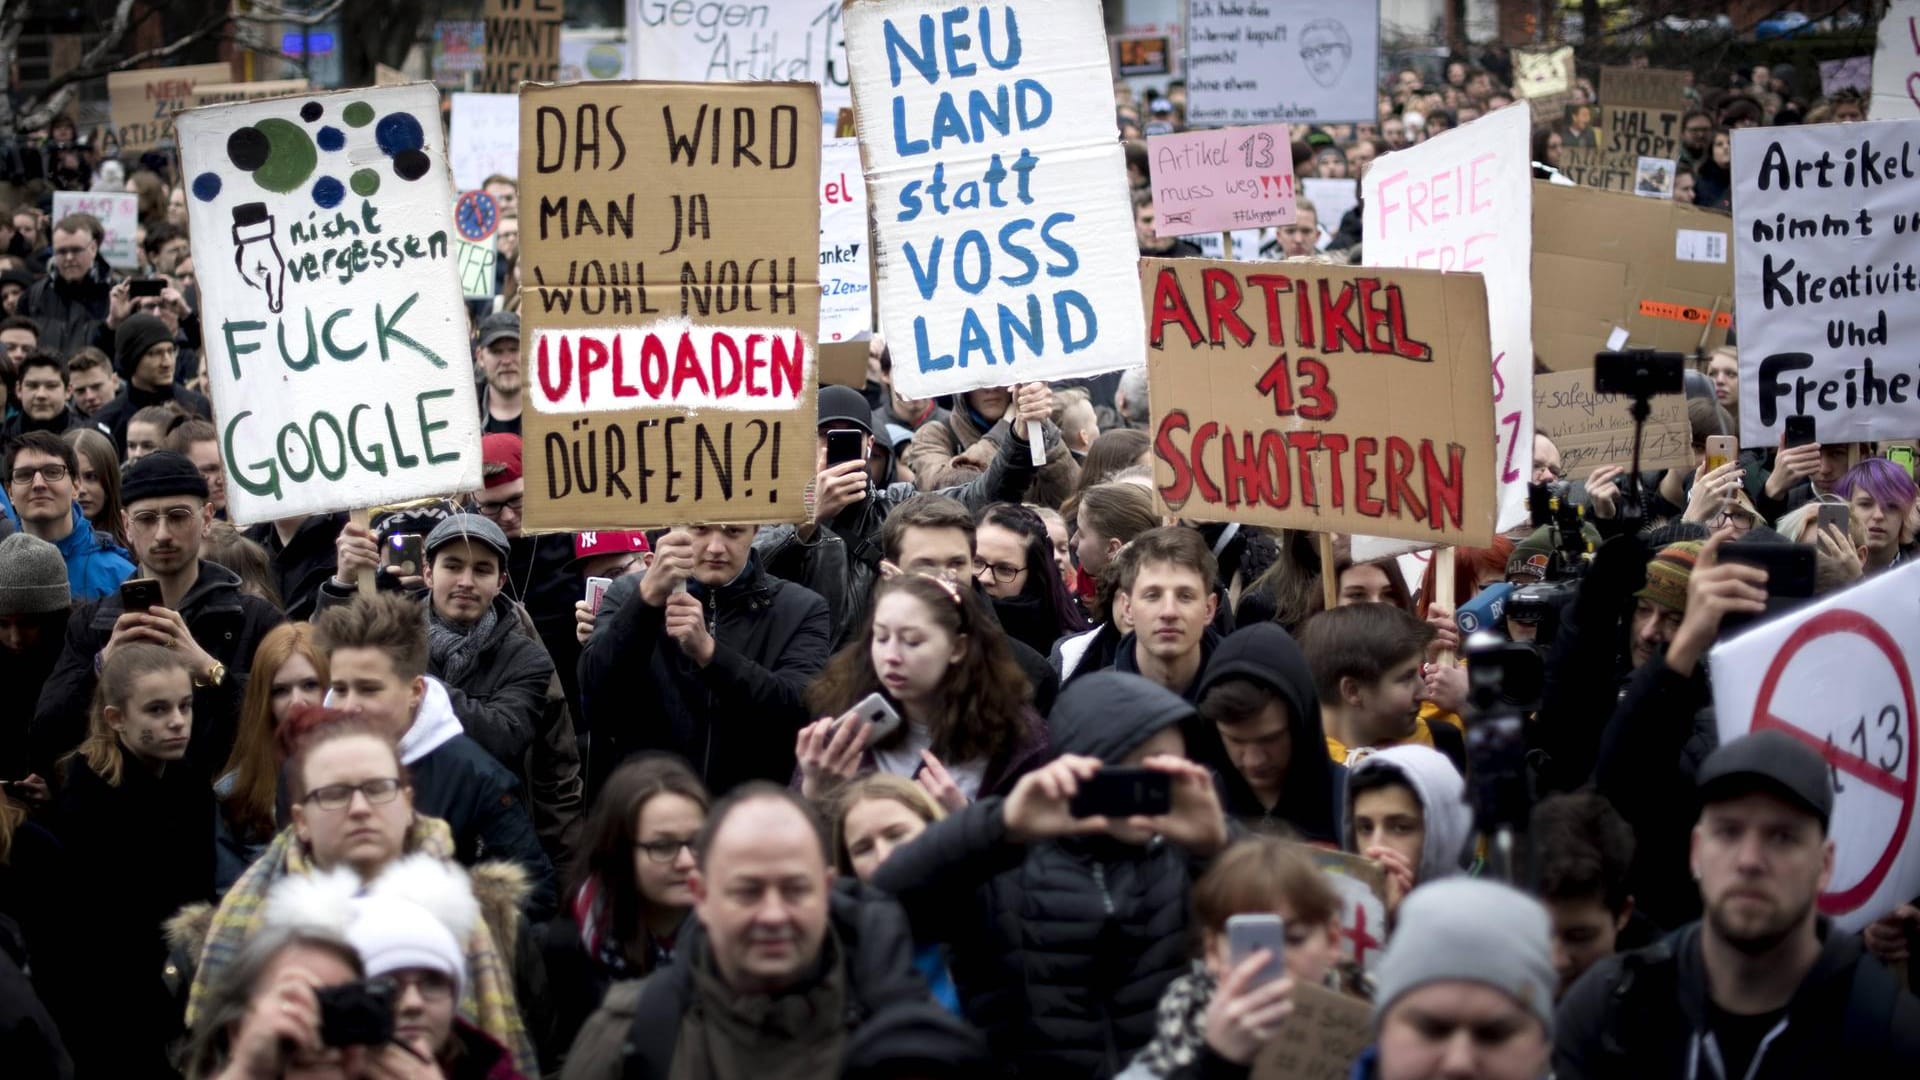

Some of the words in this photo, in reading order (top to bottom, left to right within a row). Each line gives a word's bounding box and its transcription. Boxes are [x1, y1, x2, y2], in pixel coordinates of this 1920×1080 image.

[485, 17, 561, 56] WANT
[638, 0, 769, 42] Gegen
[884, 6, 1022, 87] NEU
[705, 31, 812, 82] Artikel
[537, 104, 626, 173] DAS
[662, 104, 798, 169] WIRD
[893, 79, 1052, 156] LAND
[897, 148, 1039, 221] statt
[1158, 138, 1229, 173] Artikel
[1238, 132, 1274, 168] 13
[290, 199, 382, 246] nicht
[540, 193, 635, 240] MAN
[659, 194, 710, 255] JA
[1160, 184, 1214, 202] muss
[1378, 152, 1497, 240] FREIE
[1752, 209, 1872, 242] nimmt
[287, 230, 448, 285] vergessen
[534, 260, 659, 315] WOHL
[681, 257, 796, 316] NOCH
[820, 244, 860, 265] anke!
[902, 212, 1079, 300] VOSS
[1762, 254, 1920, 310] Kreativit
[222, 292, 448, 380] FUCK
[914, 290, 1098, 374] LAND
[1150, 267, 1434, 361] ARTIKEL
[537, 330, 804, 406] UPLOADEN
[1255, 352, 1338, 421] 13
[1759, 352, 1920, 427] Freihe
[224, 388, 460, 501] GOOGLE
[545, 416, 781, 504] DÜRFEN?!
[1154, 408, 1465, 532] SCHOTTERN
[1851, 704, 1904, 774] 13
